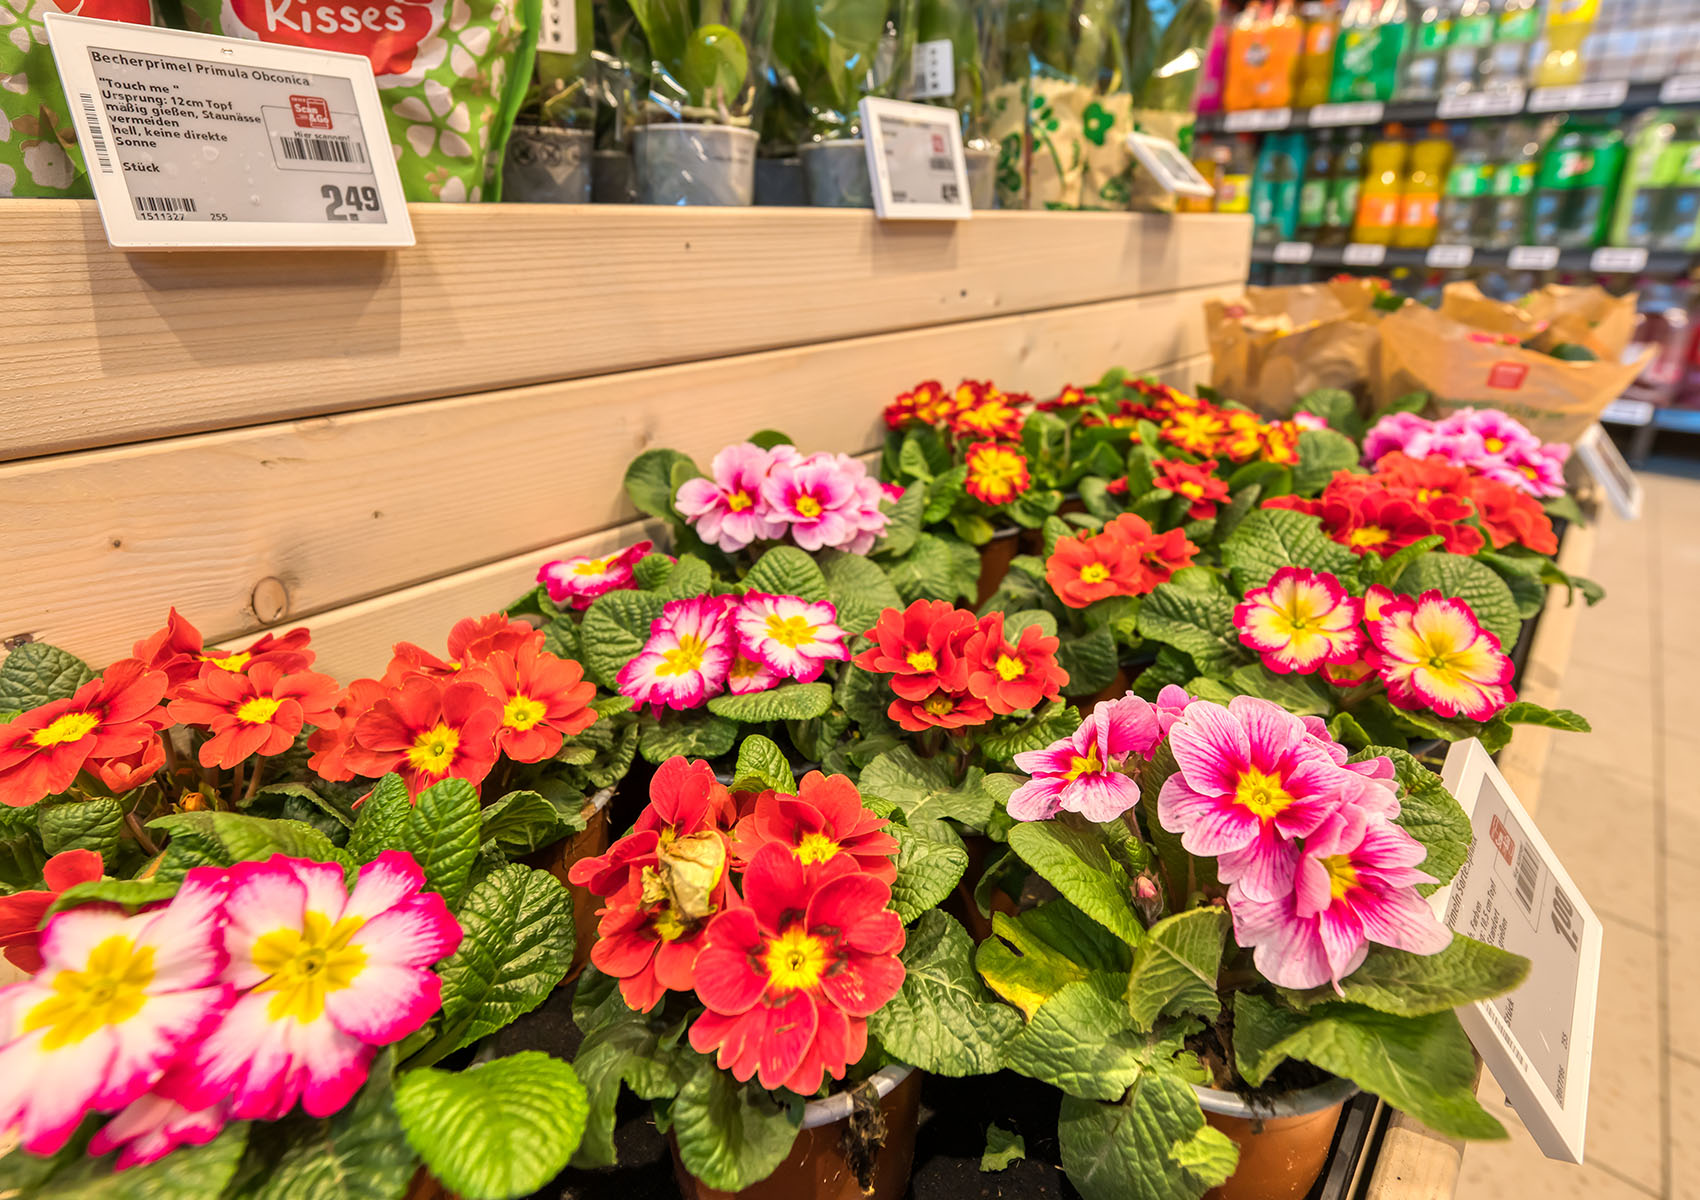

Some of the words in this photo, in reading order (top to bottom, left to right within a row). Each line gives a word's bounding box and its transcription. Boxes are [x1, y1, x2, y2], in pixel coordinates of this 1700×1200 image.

[264, 0, 406, 33] Kisses
[91, 51, 192, 72] Becherprimel
[195, 63, 249, 79] Primula
[251, 70, 310, 86] Obconica
[149, 84, 169, 93] me
[102, 90, 168, 106] Ursprung:
[171, 96, 204, 107] 12cm
[205, 99, 233, 112] Topf
[106, 102, 148, 115] mäßig
[152, 105, 199, 119] gießen,
[201, 110, 261, 124] Staunässe
[109, 115, 180, 127] vermeiden
[112, 125, 142, 137] hell,
[144, 126, 181, 138] keine
[184, 129, 228, 142] direkte
[115, 136, 157, 148] Sonne
[123, 161, 160, 173] Stück
[320, 184, 381, 221] 2.49
[140, 212, 185, 221] 1511327
[210, 213, 228, 221] 255
[1550, 885, 1579, 953] 1.00
